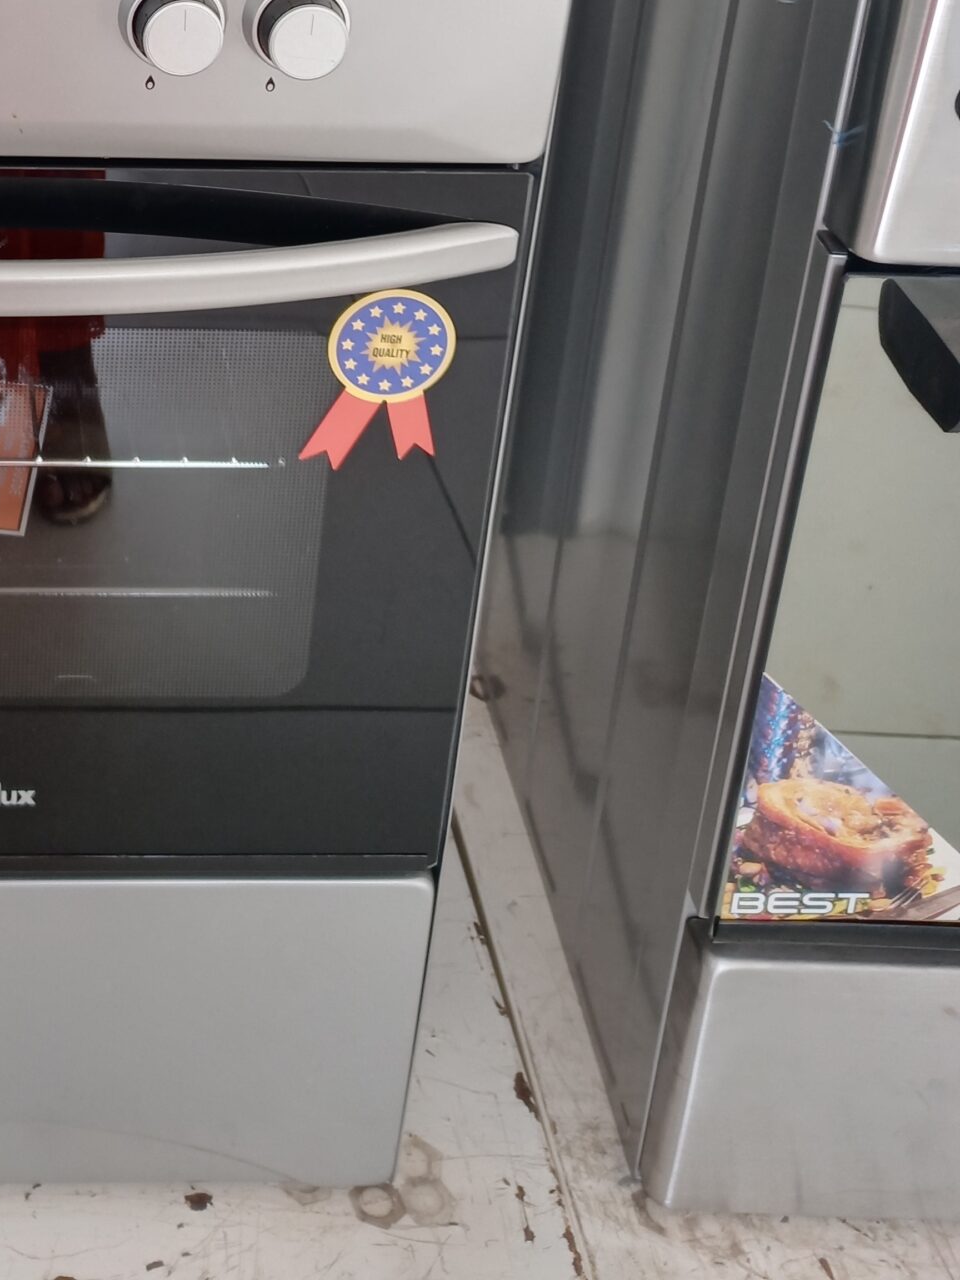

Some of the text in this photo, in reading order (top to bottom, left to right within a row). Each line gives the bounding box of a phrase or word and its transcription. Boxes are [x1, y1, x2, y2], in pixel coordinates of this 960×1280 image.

[380, 334, 402, 344] HIGH
[372, 347, 410, 358] QUALITY
[729, 892, 870, 916] BEST
